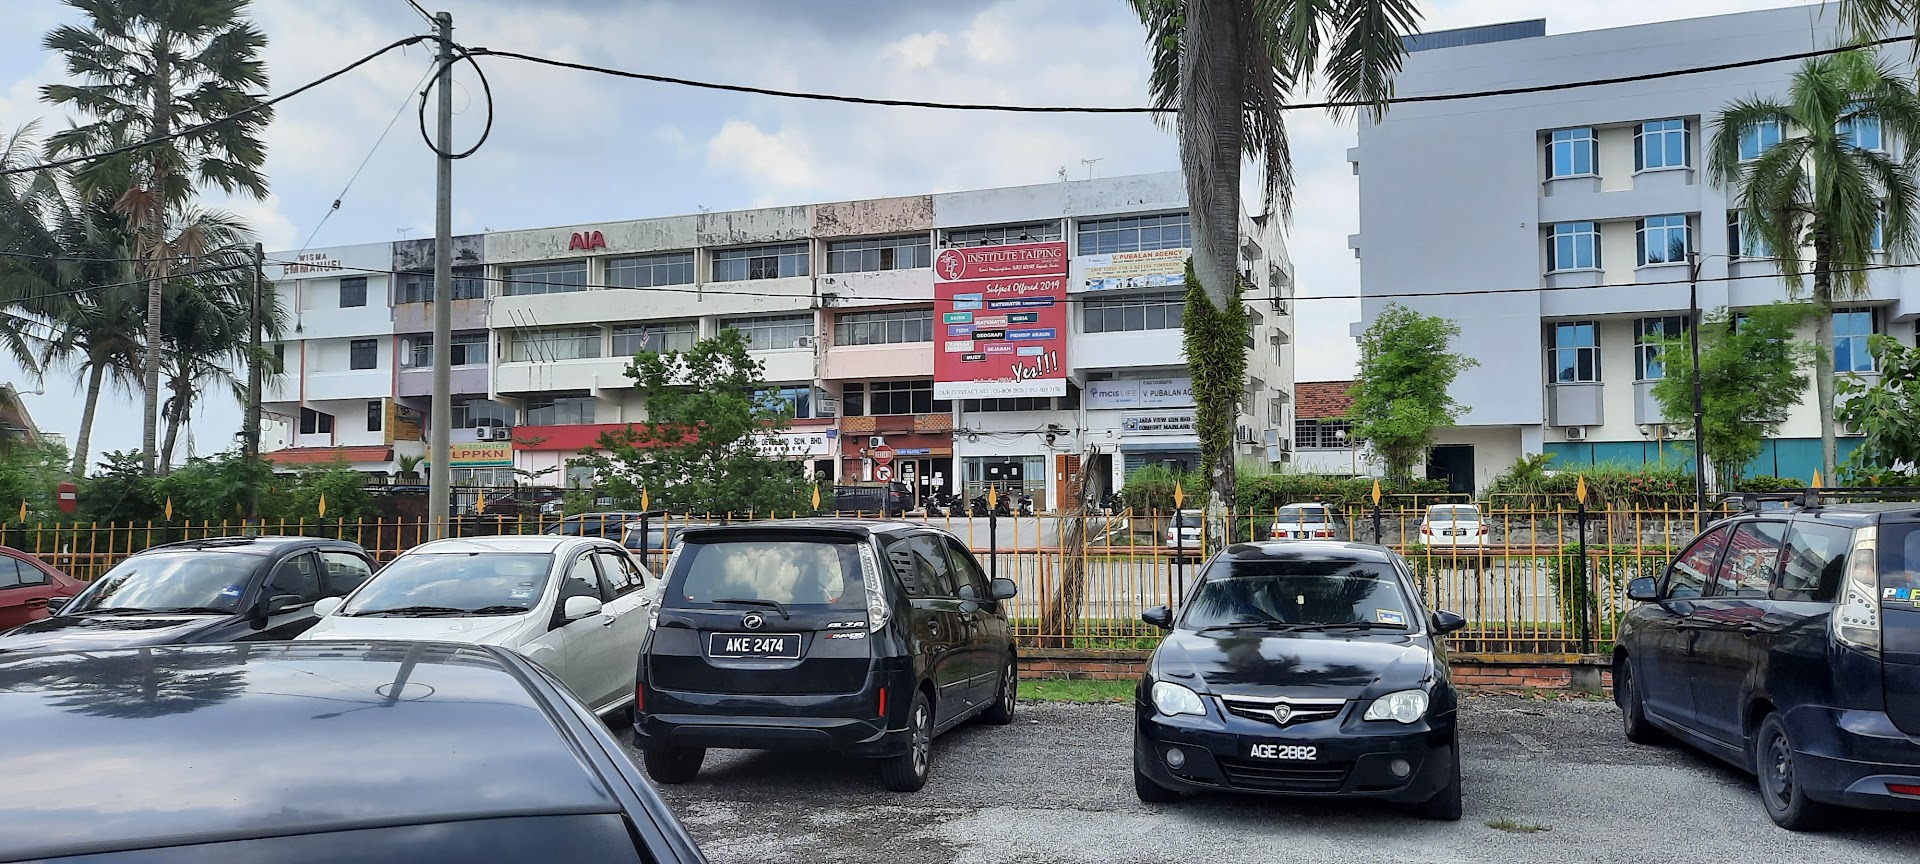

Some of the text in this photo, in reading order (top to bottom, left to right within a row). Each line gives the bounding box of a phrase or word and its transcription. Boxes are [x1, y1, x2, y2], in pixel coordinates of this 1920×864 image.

[569, 231, 606, 250] AIA
[299, 253, 327, 261] WISMA
[967, 248, 1062, 263] INSTITUTE TAIPING
[1120, 252, 1153, 260] PUBALAN
[283, 260, 343, 275] EMMANUEL
[986, 280, 1060, 296] Subject Offered 2019
[1011, 350, 1058, 384] Yes!!!
[1150, 389, 1181, 397] PUBALAN
[452, 450, 504, 459] LPPKN
[726, 638, 784, 653] AKE 2474
[1250, 743, 1317, 760] AGE 2882
